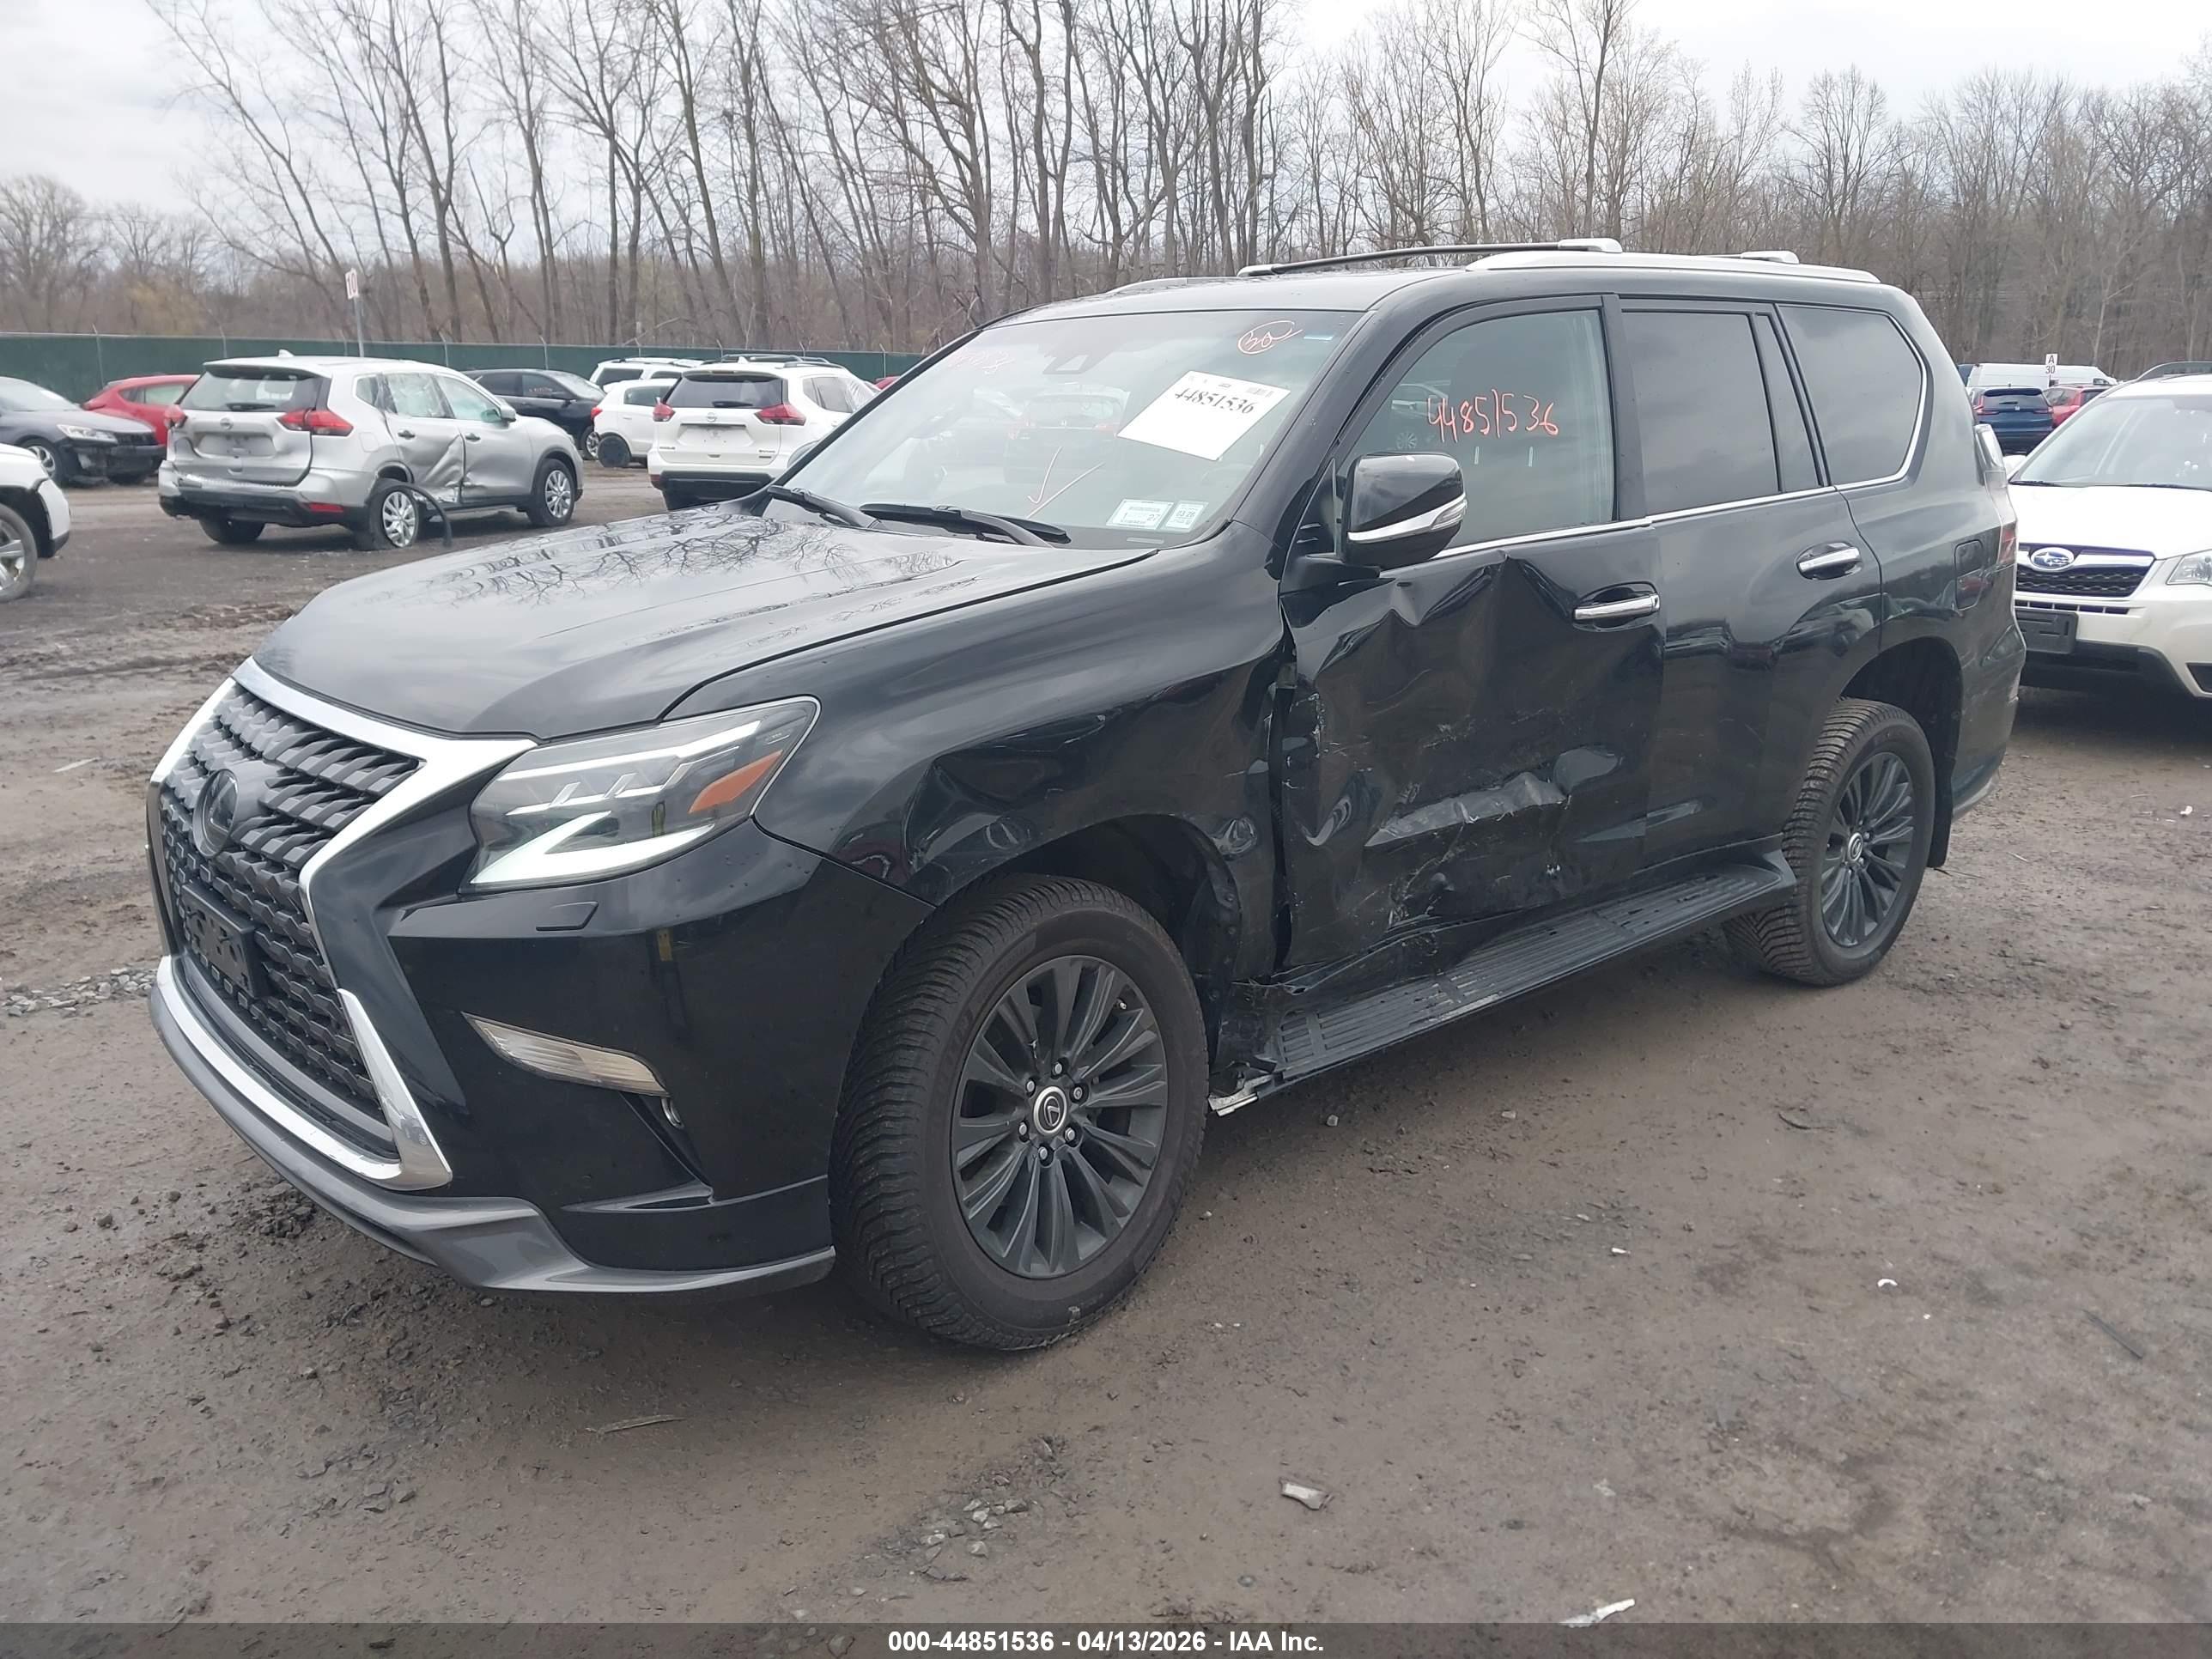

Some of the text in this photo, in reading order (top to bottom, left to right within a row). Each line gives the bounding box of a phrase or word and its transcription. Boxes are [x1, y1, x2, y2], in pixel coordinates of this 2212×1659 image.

[2048, 355, 2055, 364] A
[2045, 365, 2056, 374] 30
[1175, 387, 1255, 415] 44851536
[1427, 388, 1559, 444] 44851536
